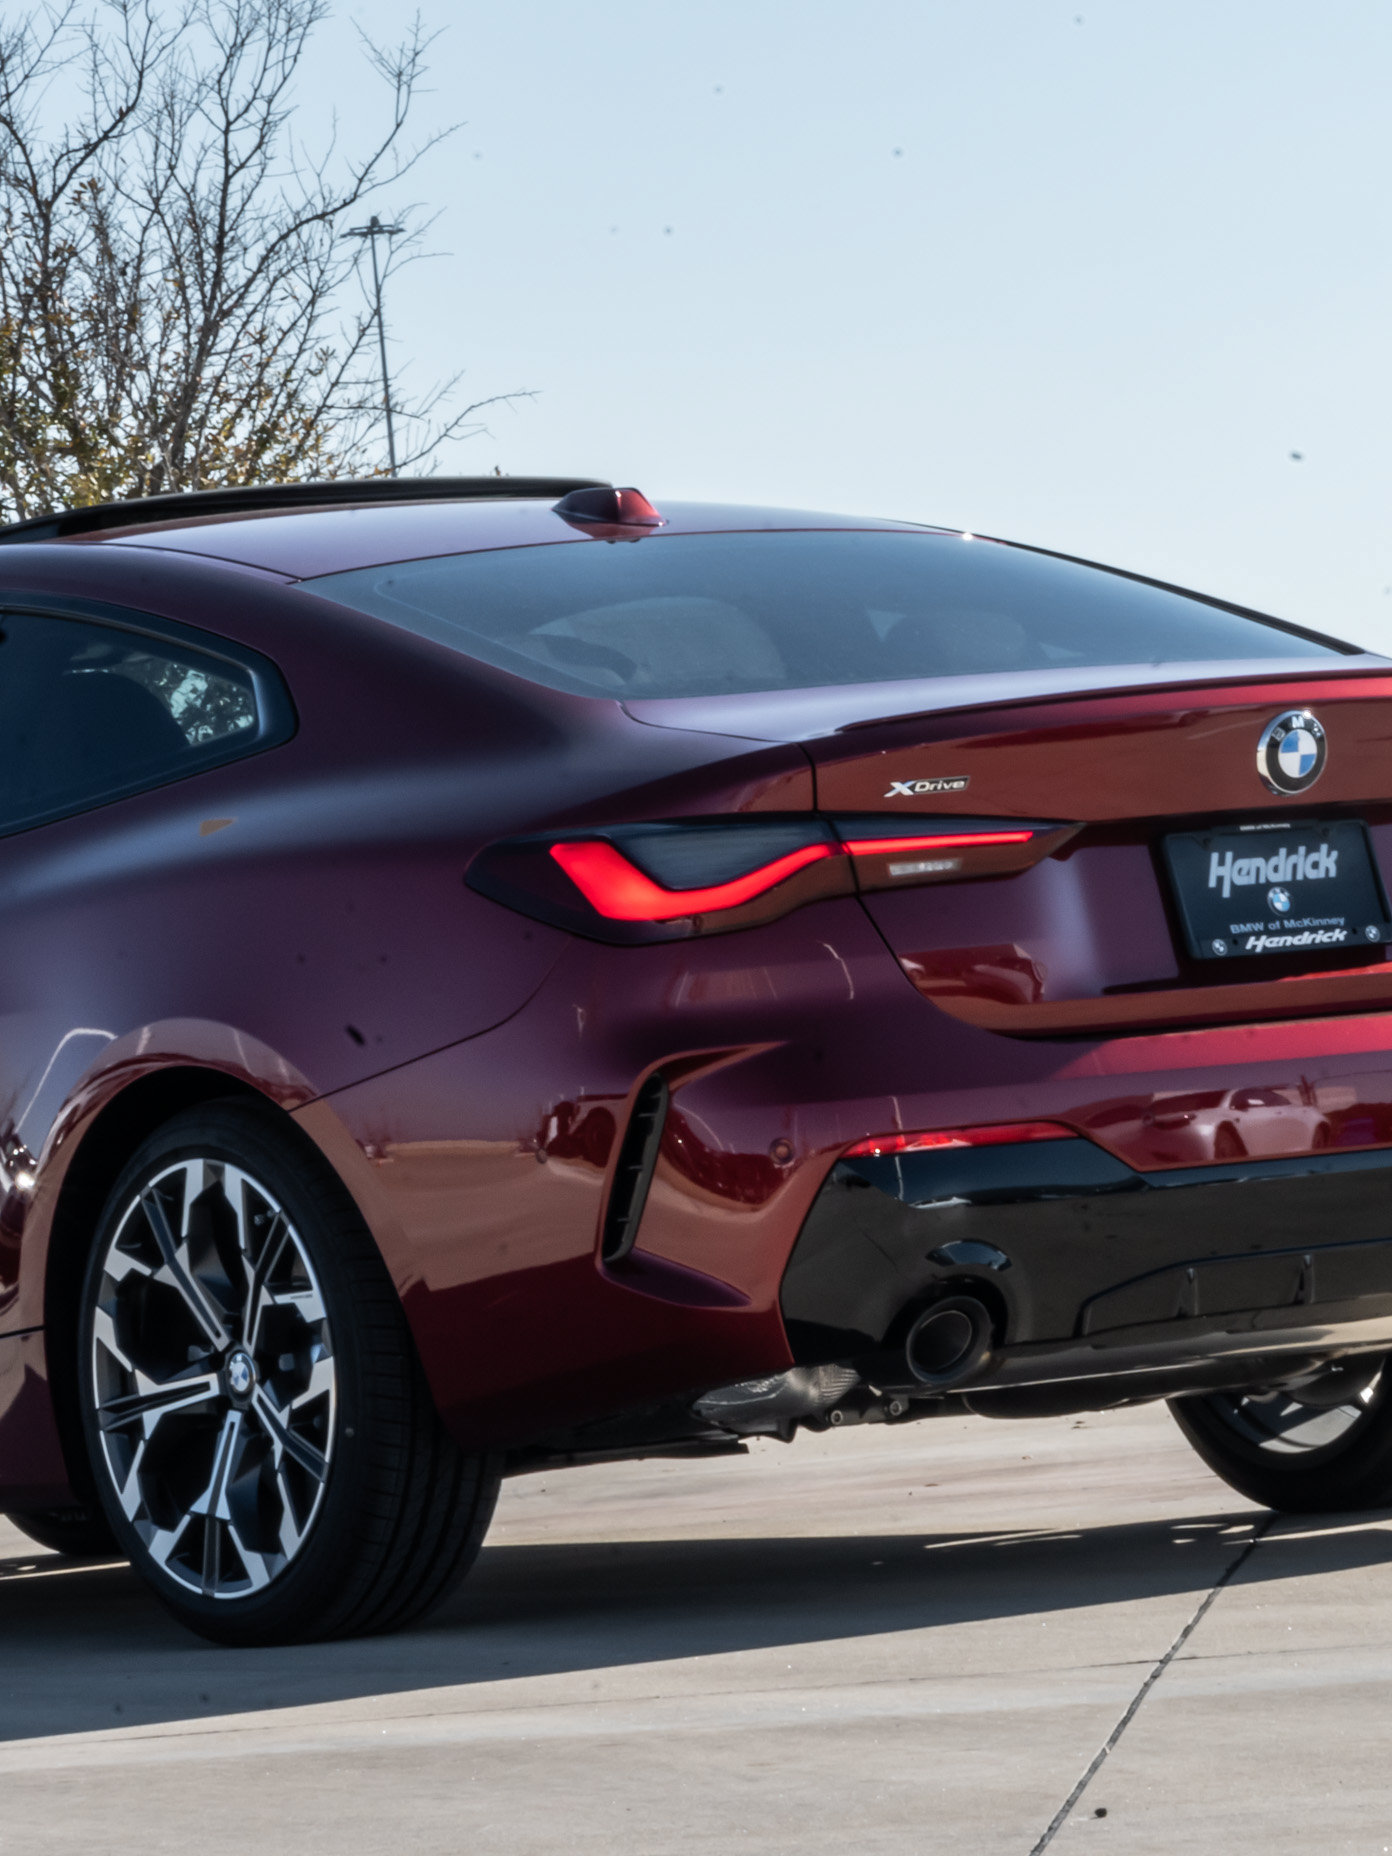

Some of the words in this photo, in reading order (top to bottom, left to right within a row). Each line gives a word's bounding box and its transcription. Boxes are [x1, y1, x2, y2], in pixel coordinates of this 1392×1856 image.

[1208, 843, 1338, 898] Hendrick
[1229, 922, 1265, 934] BMW
[1268, 920, 1281, 930] of
[1283, 917, 1345, 928] McKinney
[1245, 928, 1348, 953] Hendrick
